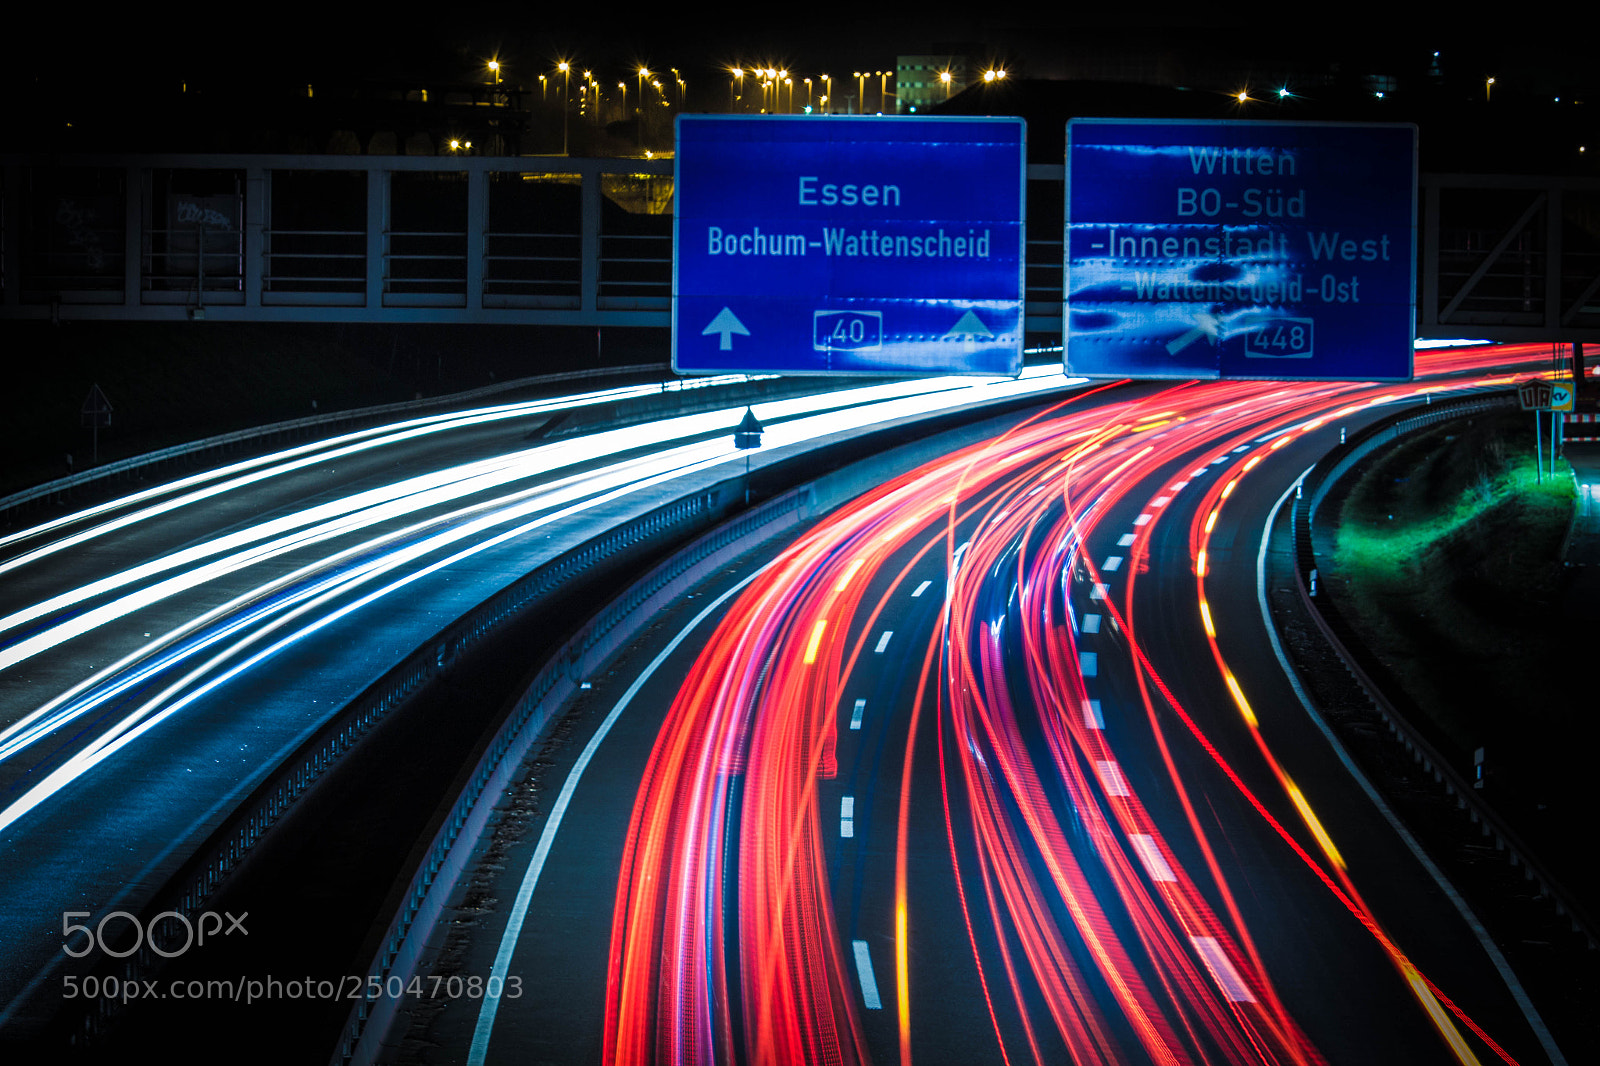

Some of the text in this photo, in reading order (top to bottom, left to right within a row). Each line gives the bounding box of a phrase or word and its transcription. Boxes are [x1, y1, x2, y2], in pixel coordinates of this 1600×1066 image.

[1187, 147, 1297, 176] Witten
[798, 176, 901, 207] Essen
[1176, 188, 1307, 219] BO-Süd
[707, 226, 991, 259] Bochum-Wattenscheid
[1091, 229, 1391, 262] -Innenstadt West
[1120, 271, 1360, 304] -Wattenscheid-Ost
[831, 319, 865, 344] 40
[1253, 326, 1306, 351] 448
